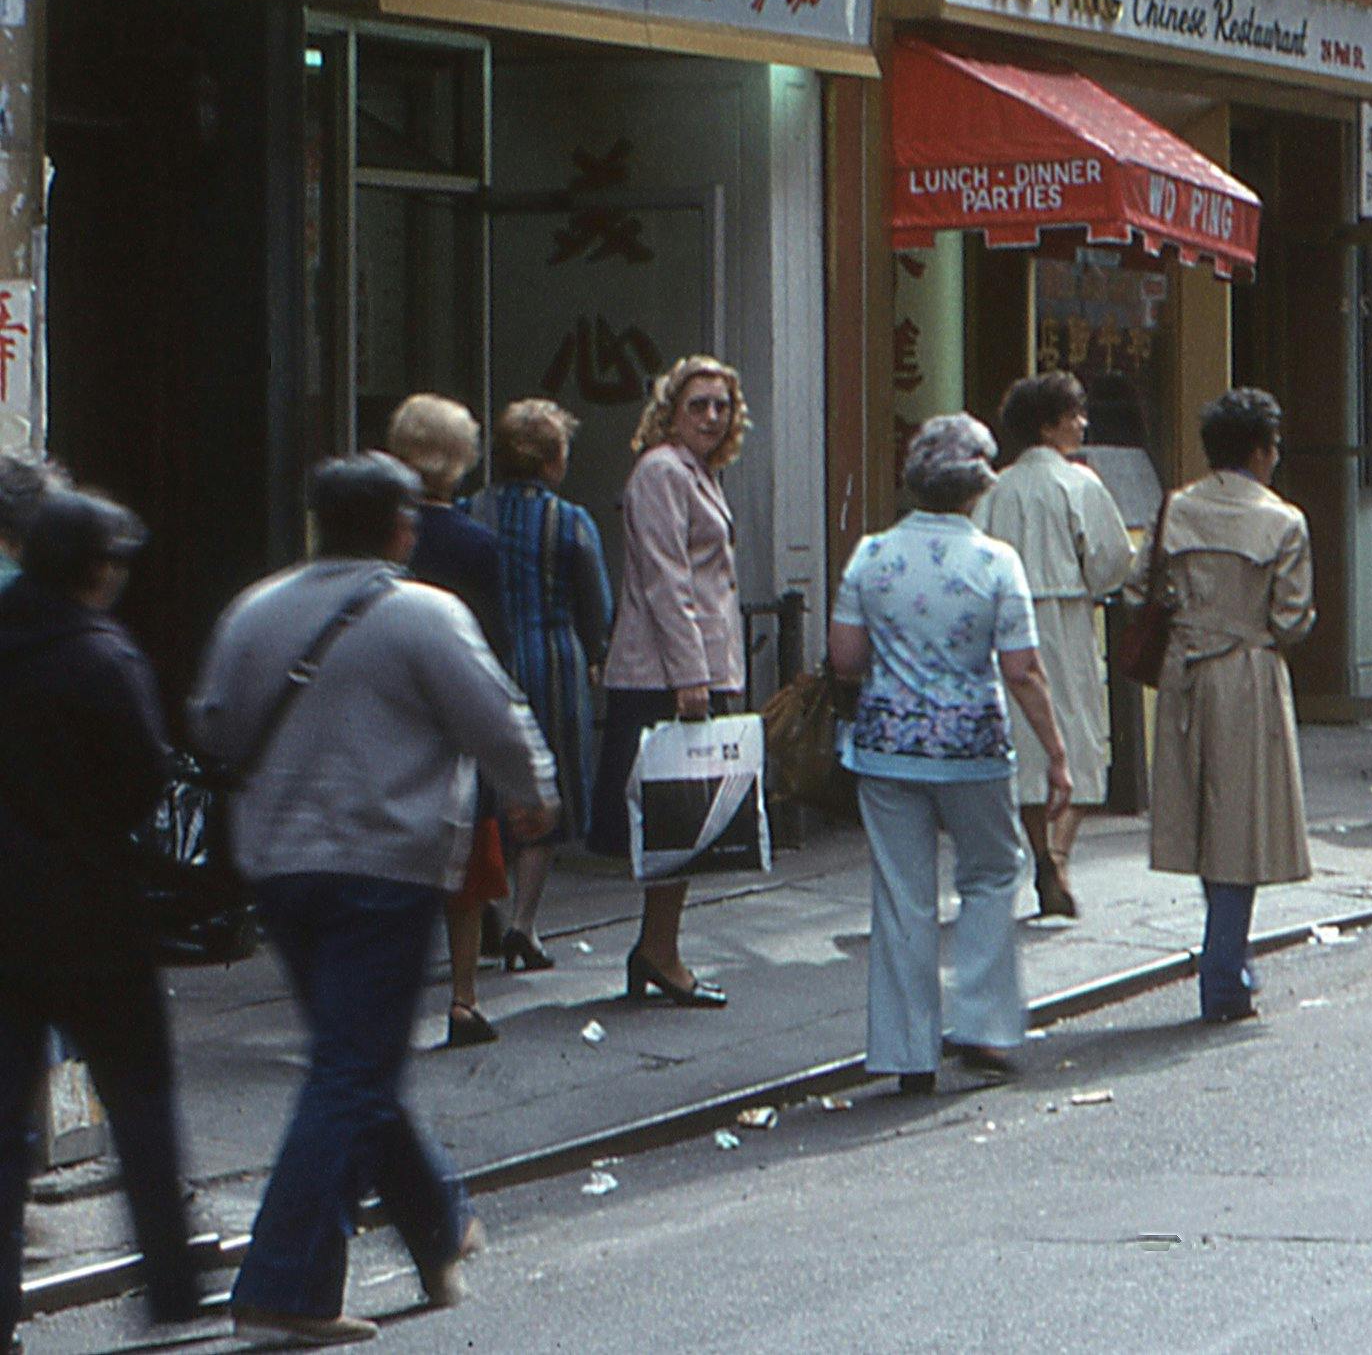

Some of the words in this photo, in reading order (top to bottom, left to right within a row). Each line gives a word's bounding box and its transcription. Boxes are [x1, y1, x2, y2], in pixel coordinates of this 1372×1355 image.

[909, 164, 989, 195] LUNCH
[1014, 159, 1101, 187] DINNER
[961, 183, 1063, 213] PARTIES
[1148, 177, 1176, 222] WO
[1189, 191, 1234, 240] PING
